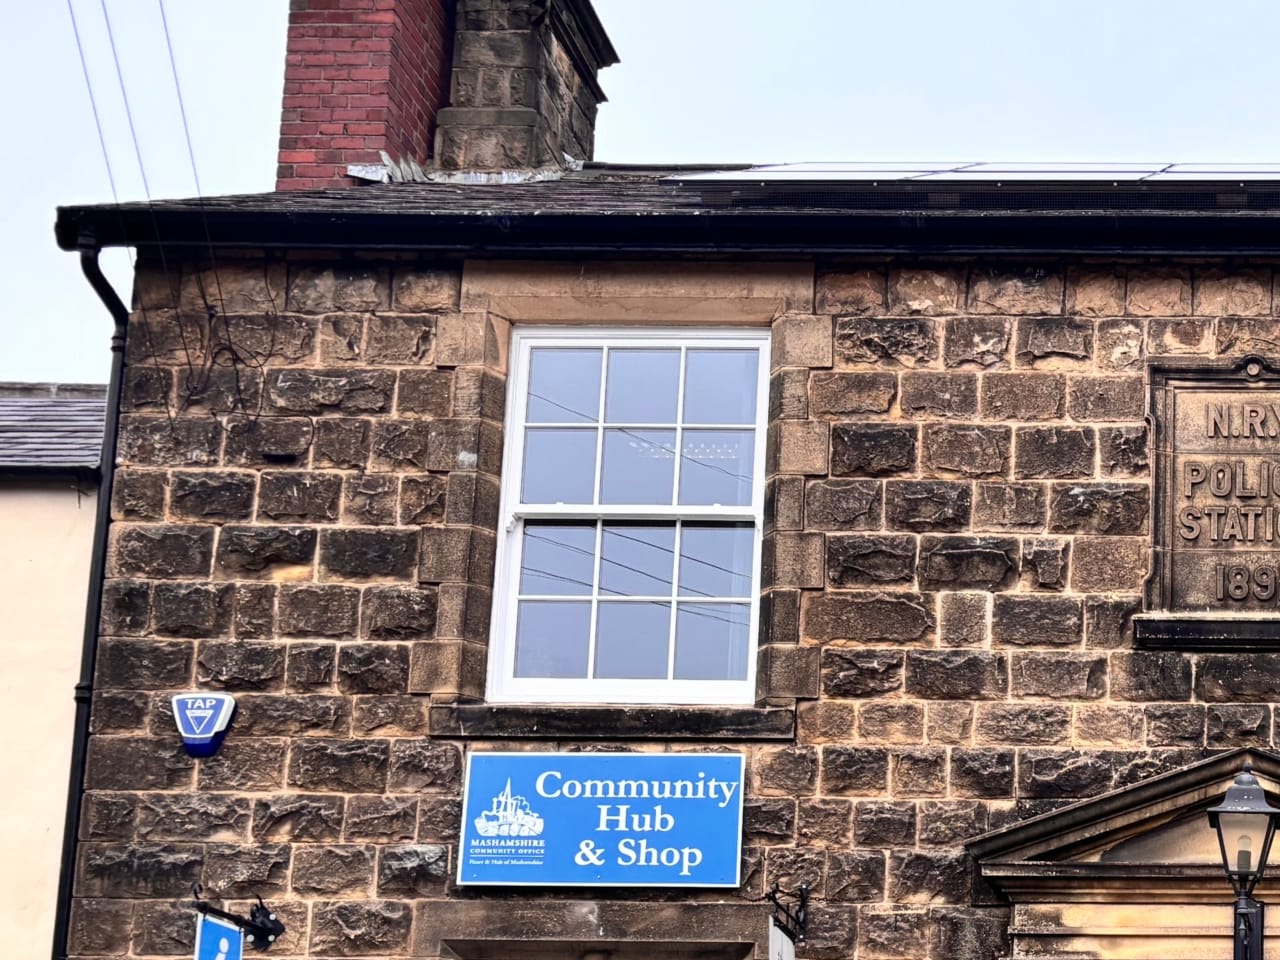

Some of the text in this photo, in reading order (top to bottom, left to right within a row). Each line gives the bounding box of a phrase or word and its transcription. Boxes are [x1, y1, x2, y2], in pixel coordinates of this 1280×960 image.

[184, 698, 217, 709] TAP
[536, 771, 739, 808] Community
[595, 804, 675, 833] Hub
[470, 838, 545, 848] MASHAMSHIRE
[574, 838, 703, 877] & Shop
